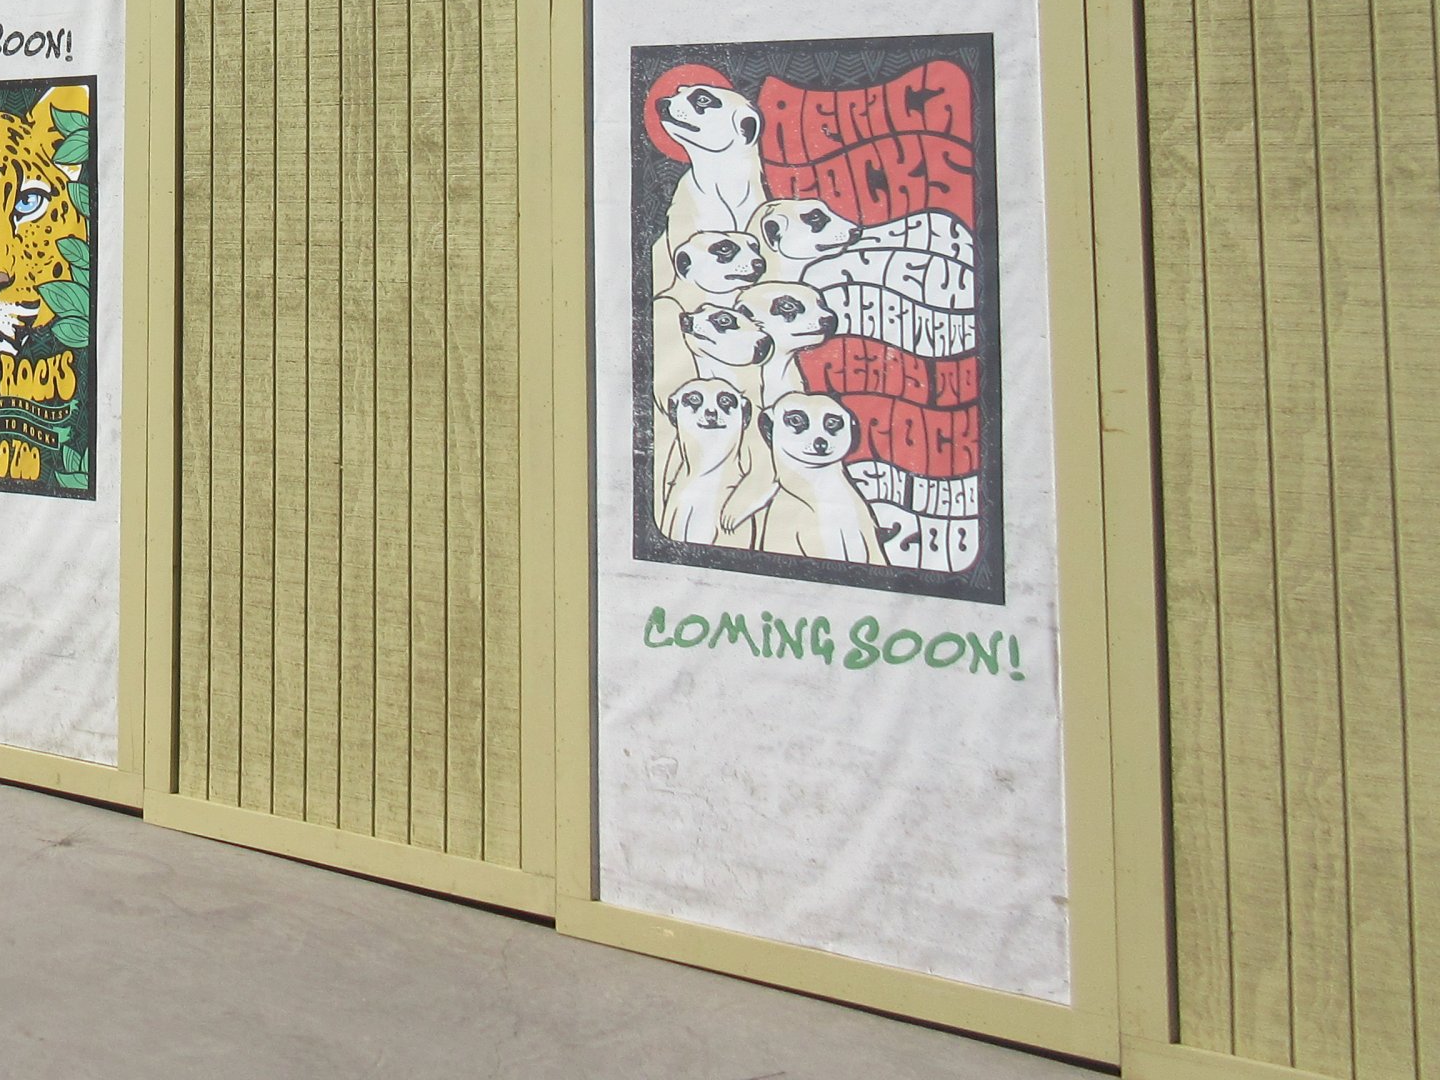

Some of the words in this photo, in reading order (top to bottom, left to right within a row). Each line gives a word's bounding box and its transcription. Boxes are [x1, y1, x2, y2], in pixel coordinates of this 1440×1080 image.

[757, 59, 973, 165] AFRICA
[762, 133, 975, 230] ROCKS
[848, 212, 974, 268] SIX
[802, 250, 975, 309] NEW
[822, 284, 976, 358] HABITATS
[0, 350, 77, 401] ROCKS
[5, 419, 17, 429] TO
[10, 439, 42, 481] ZOO
[844, 395, 979, 477] ROCK
[869, 501, 979, 573] ZOO
[642, 605, 835, 670] COMING
[843, 613, 1027, 682] SOON!
